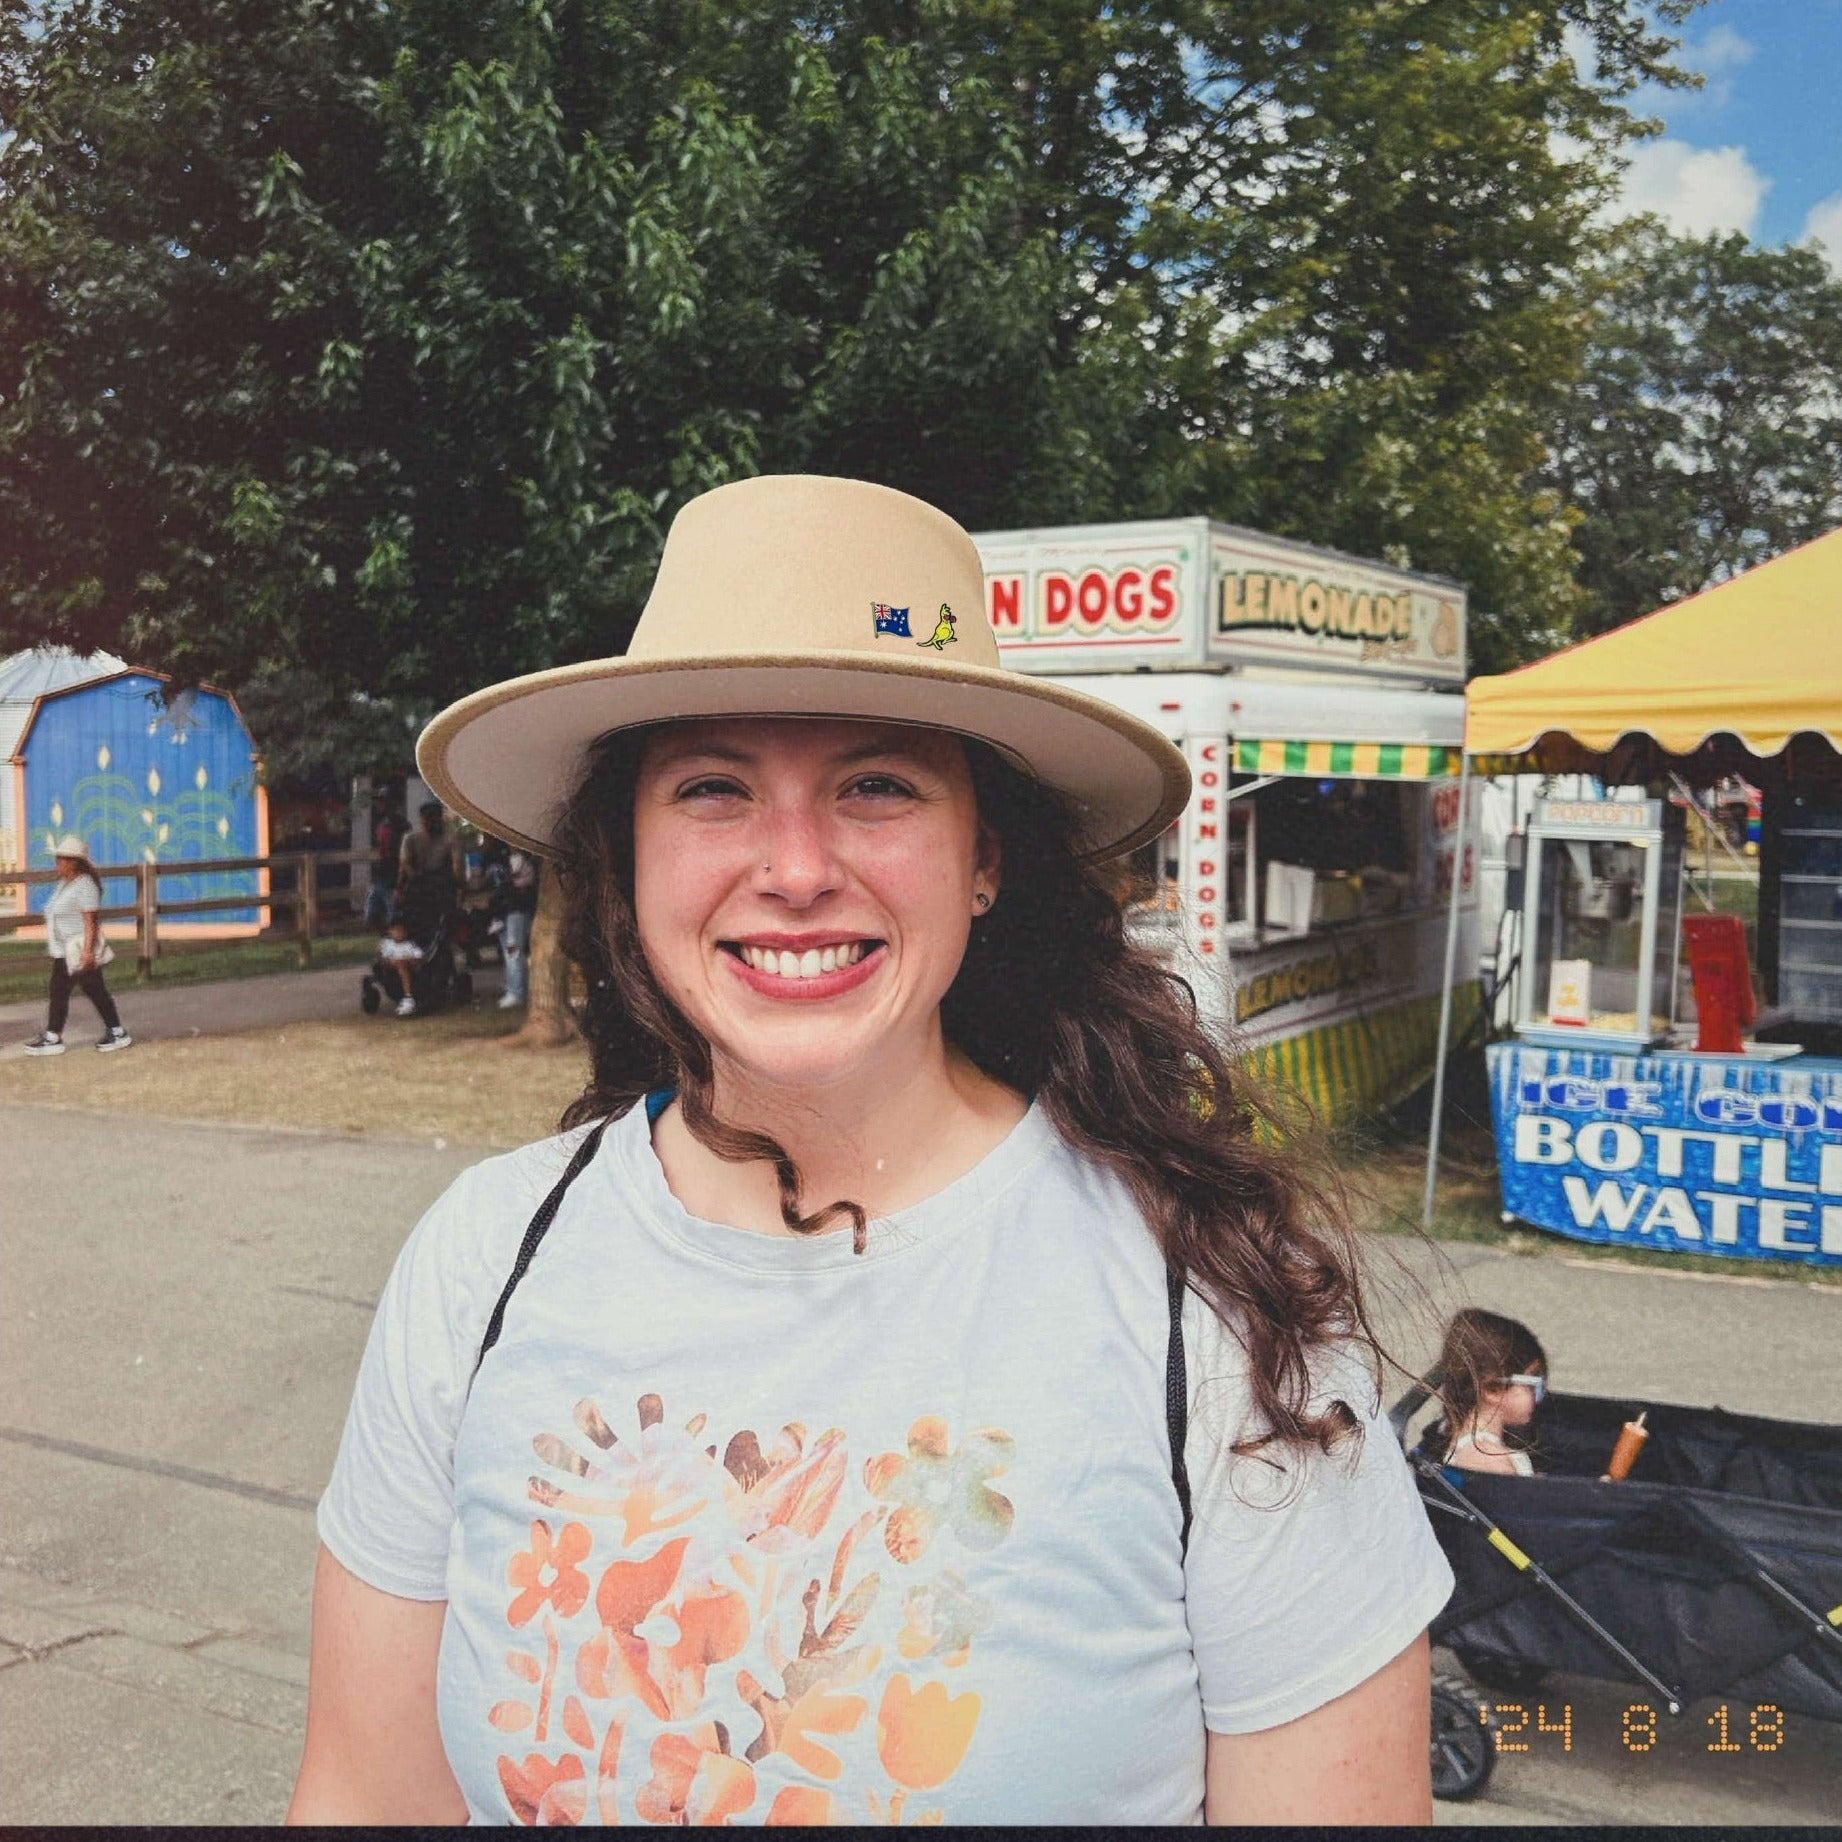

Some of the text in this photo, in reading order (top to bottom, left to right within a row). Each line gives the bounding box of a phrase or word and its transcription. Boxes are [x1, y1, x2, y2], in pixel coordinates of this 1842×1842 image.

[991, 568, 1175, 627] N DOGS
[1220, 569, 1413, 640] LEMONADE
[1198, 744, 1219, 954] CORN DOGS
[1517, 1072, 1663, 1117] ICE
